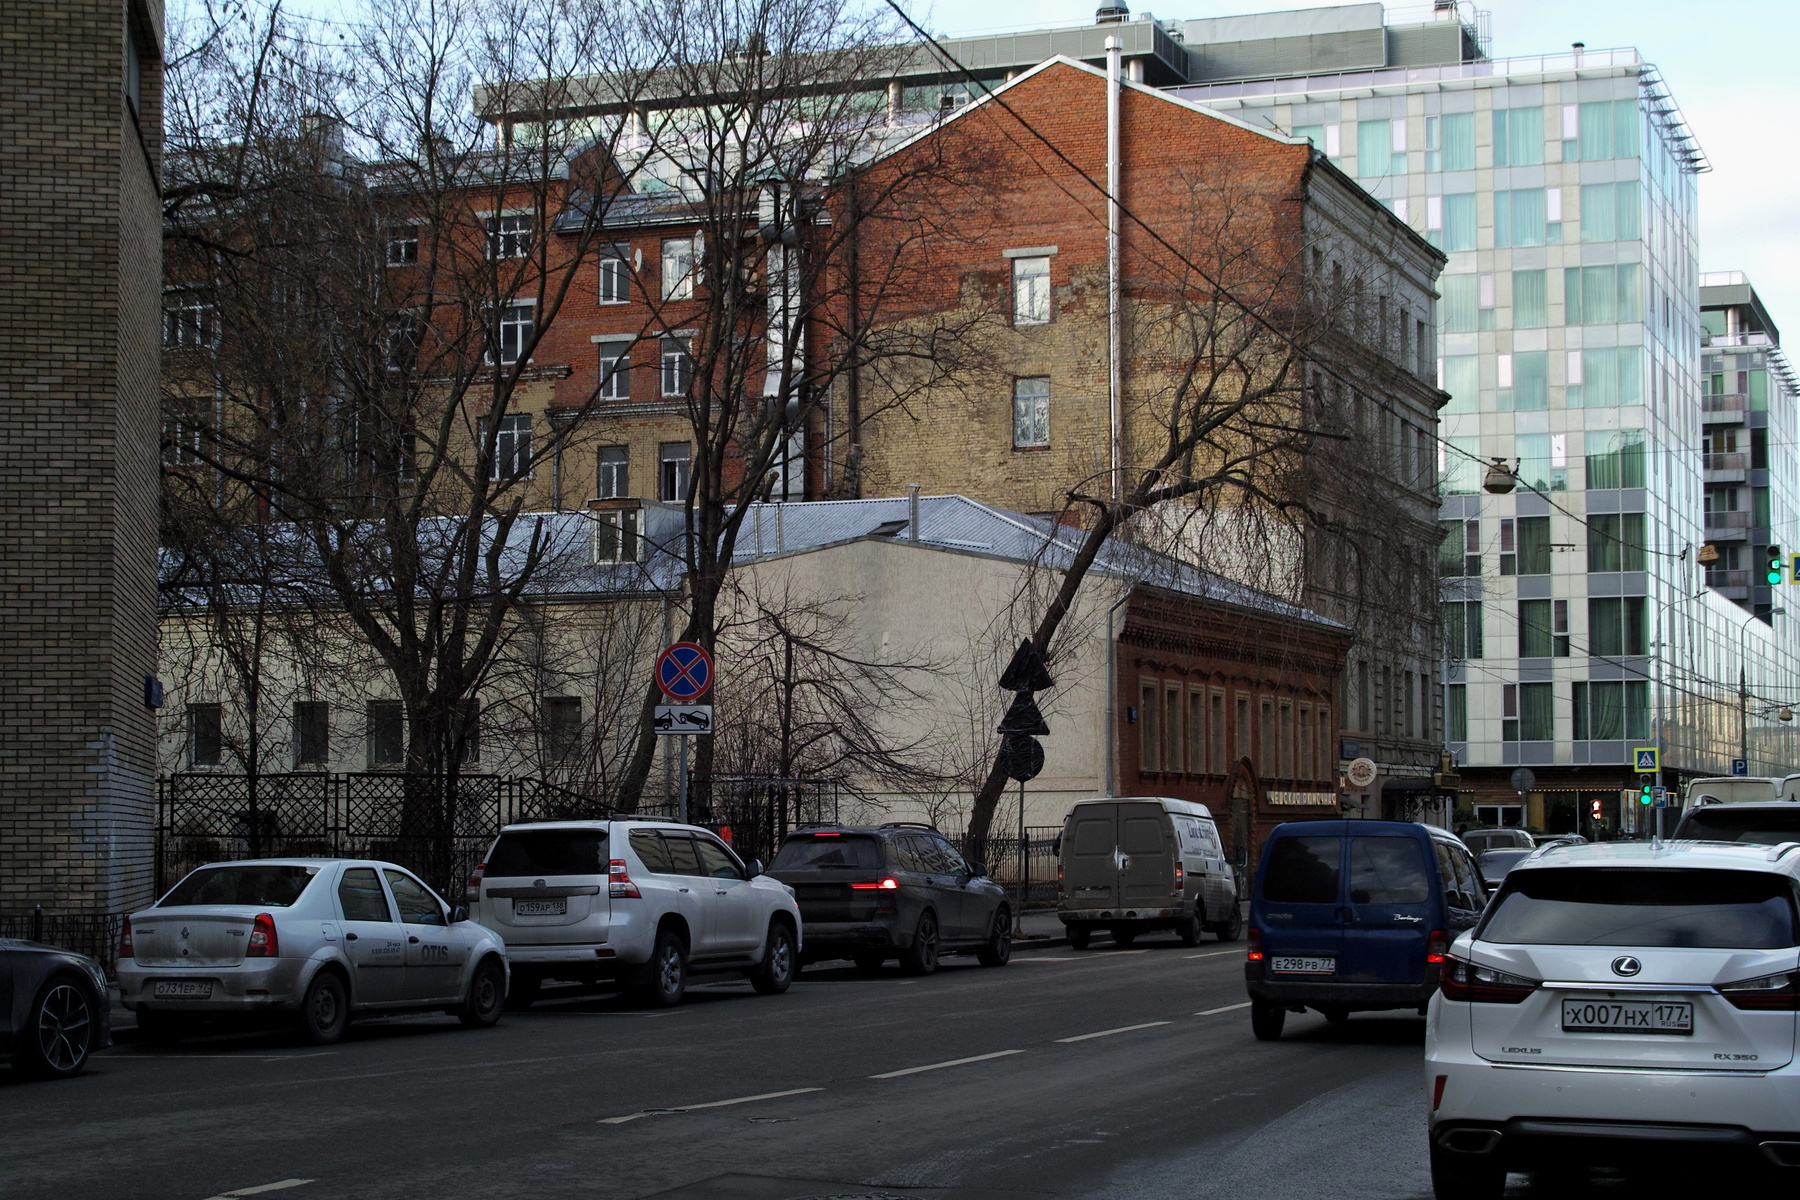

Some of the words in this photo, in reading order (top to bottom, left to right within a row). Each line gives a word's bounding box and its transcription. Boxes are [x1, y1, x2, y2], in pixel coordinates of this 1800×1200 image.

[1736, 761, 1745, 772] P
[520, 902, 550, 912] О159АР
[1392, 913, 1423, 923] Berlingo
[422, 945, 448, 961] OTIS
[159, 983, 195, 993] О731ЕР
[1654, 1005, 1685, 1021] 177
